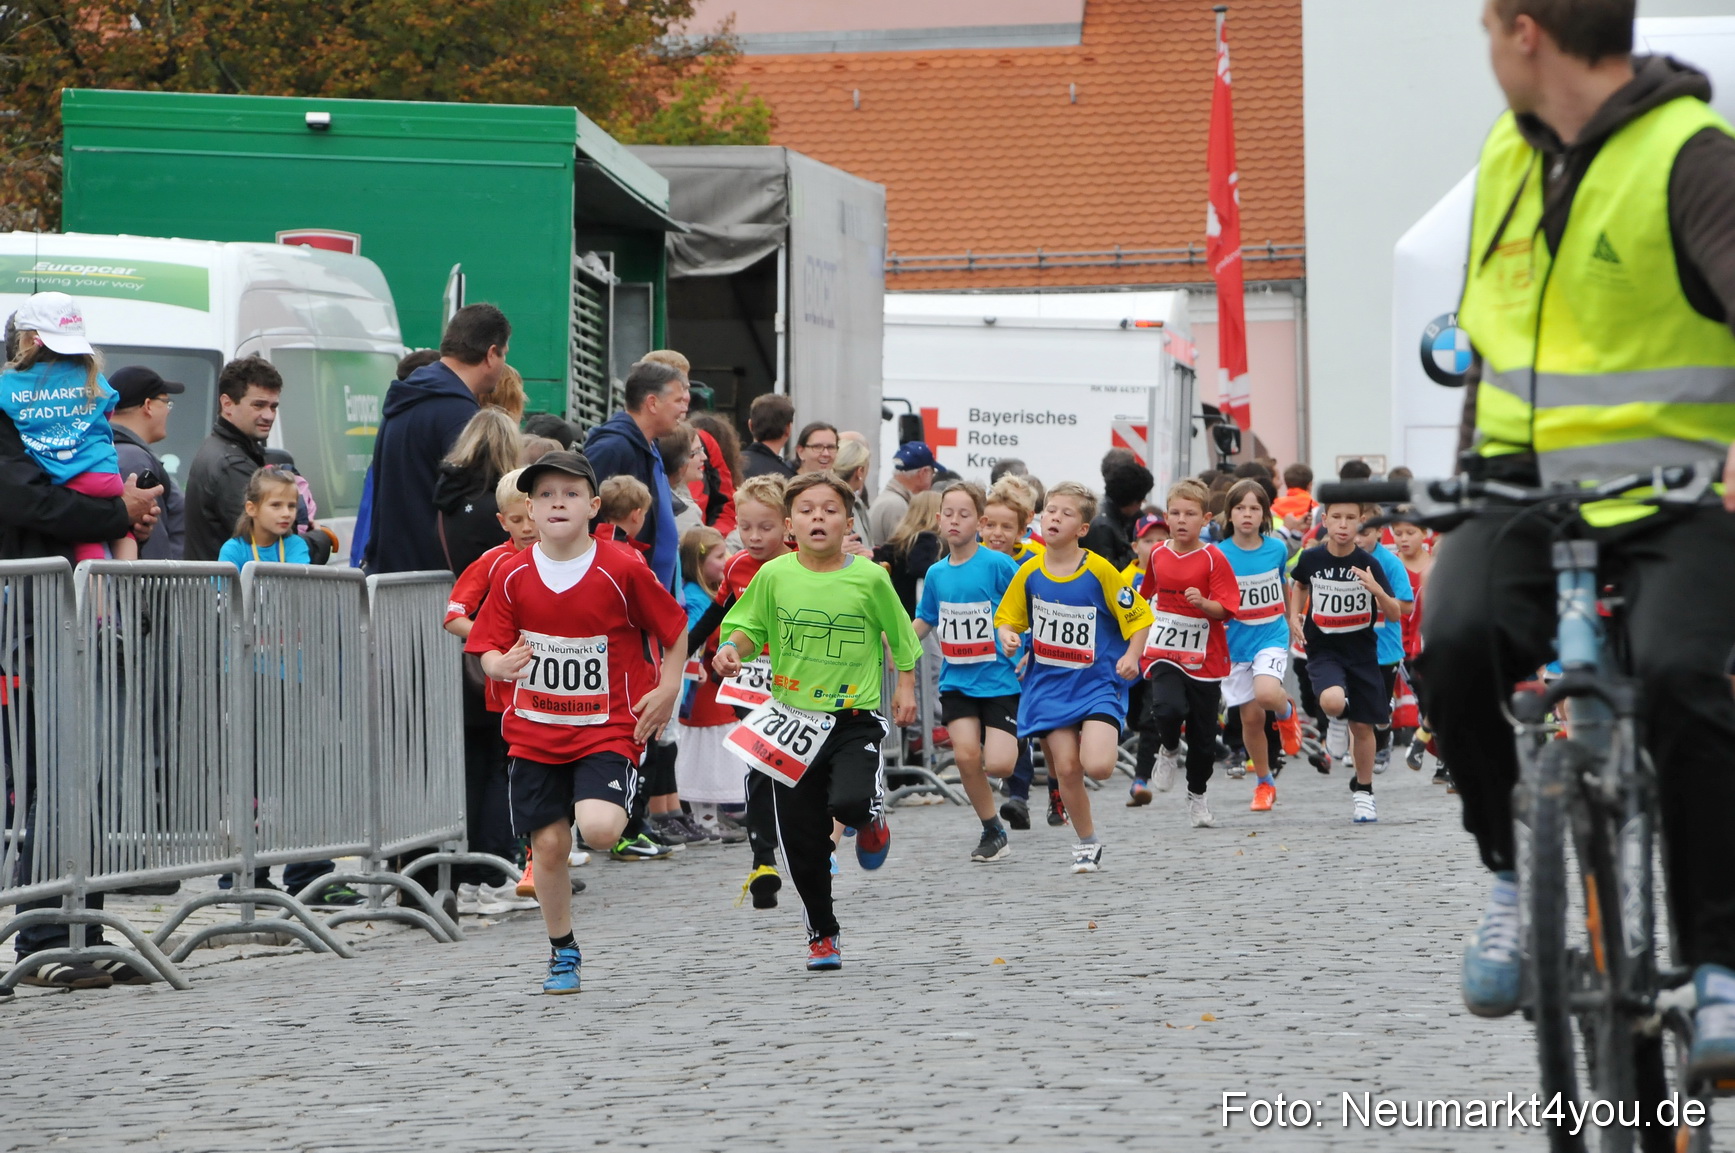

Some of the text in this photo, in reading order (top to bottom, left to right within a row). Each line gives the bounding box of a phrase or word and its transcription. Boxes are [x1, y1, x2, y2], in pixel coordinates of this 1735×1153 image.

[32, 261, 137, 275] Europcar
[16, 276, 144, 291] moving your way
[11, 387, 92, 403] NEUMARKTE
[19, 403, 97, 420] STADTLAUF
[968, 408, 1077, 427] Bayerisches
[967, 430, 1019, 447] Rotes
[967, 452, 1000, 468] Kre
[1314, 567, 1334, 580] EW
[1239, 582, 1279, 607] 7600
[1313, 583, 1363, 593] PARTL Neumarkt
[1033, 603, 1086, 620] PARTL Neumarkt
[1319, 592, 1367, 614] 7093
[950, 608, 981, 616] Neumarkt
[776, 606, 866, 659] PF
[942, 617, 989, 641] 7112
[1038, 615, 1090, 646] 7188
[1171, 619, 1201, 629] Neumarkt
[1155, 625, 1201, 649] 7211
[525, 640, 594, 655] ARTL Neumarkt
[952, 646, 973, 656] Leon
[1038, 645, 1083, 661] Konstantin
[529, 654, 602, 691] 7008
[532, 695, 592, 713] Sebastian
[753, 706, 819, 757] 7805
[751, 739, 775, 763] Max
